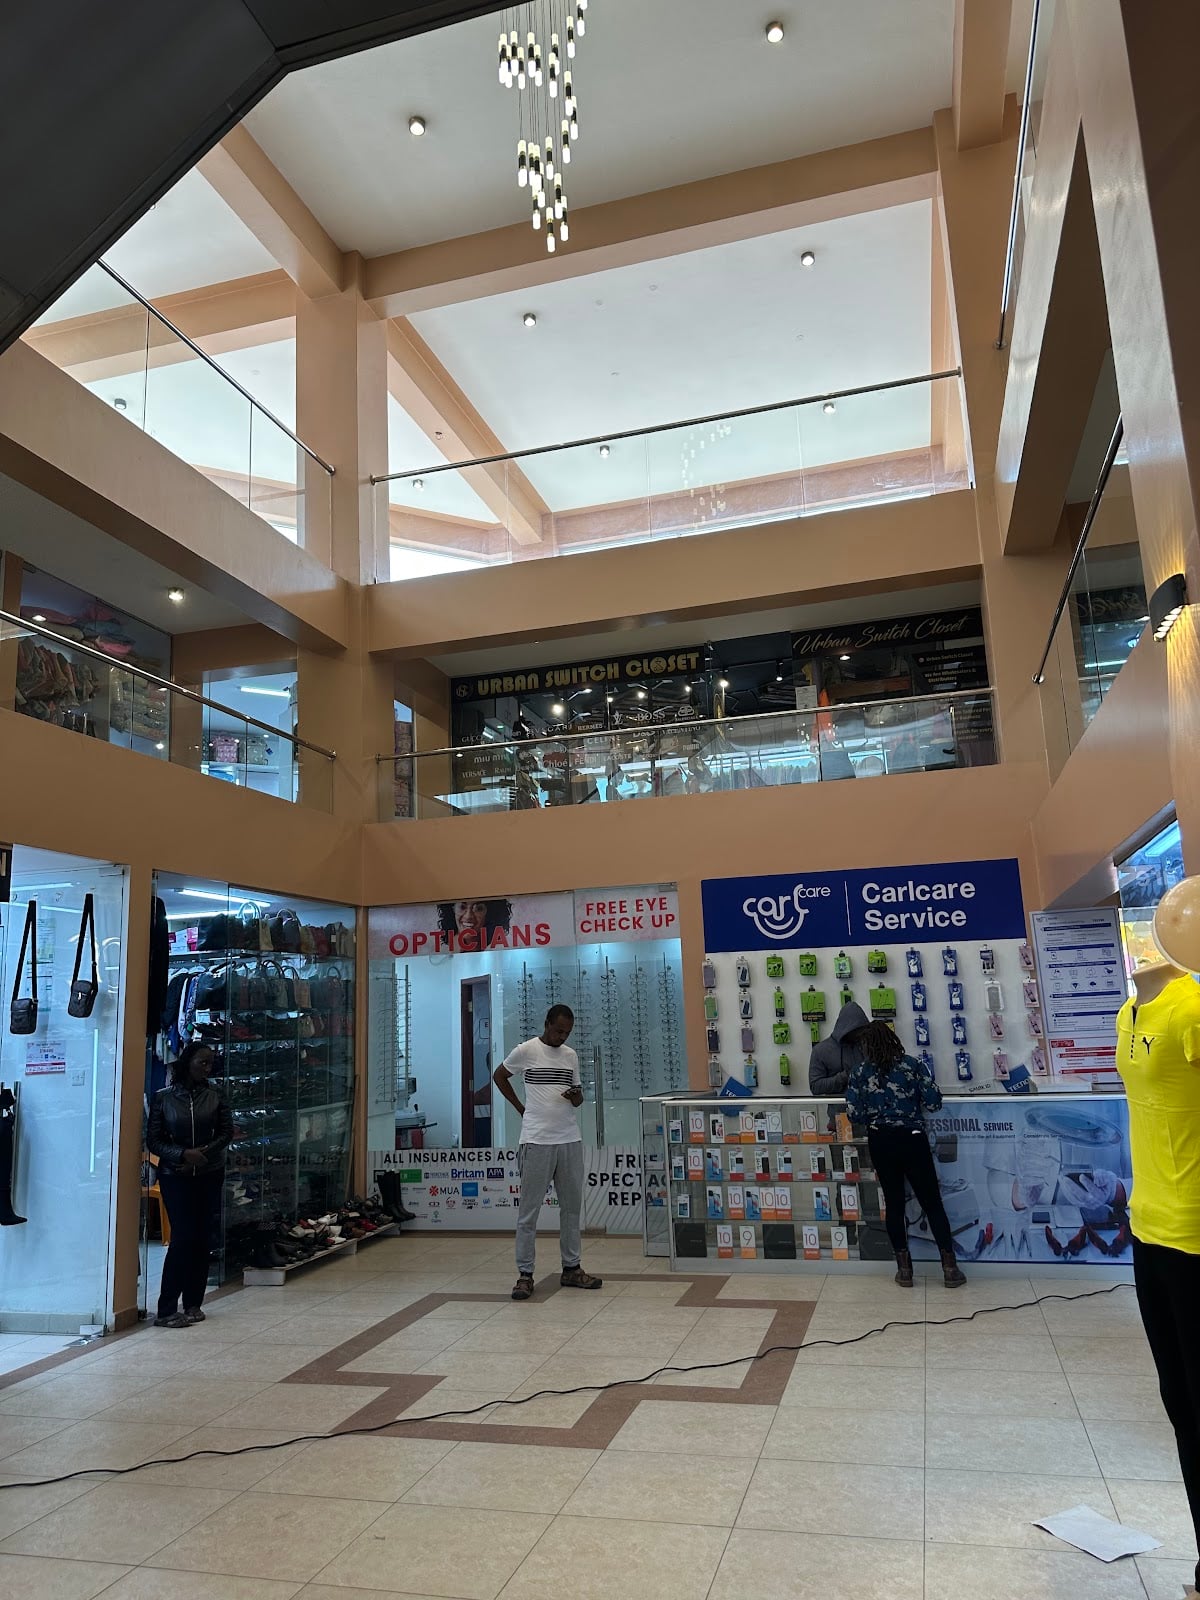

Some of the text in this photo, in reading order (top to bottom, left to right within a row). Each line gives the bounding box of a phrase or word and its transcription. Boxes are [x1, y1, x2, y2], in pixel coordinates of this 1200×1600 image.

[793, 616, 972, 654] Urban Switch Closet
[477, 652, 700, 696] URBAN SWITCH CLOSET
[798, 885, 831, 898] care
[862, 880, 976, 904] Carlcare
[585, 897, 668, 916] FREE EYE
[580, 913, 676, 934] CHECK UP
[864, 907, 967, 931] Service
[389, 923, 551, 956] OPTICIANS
[691, 1117, 703, 1130] 10
[741, 1116, 754, 1130] 10
[801, 1115, 815, 1130] 10
[983, 1122, 1014, 1132] SERVICE
[383, 1153, 404, 1164] ALL
[409, 1151, 492, 1164] INSURANCES
[689, 1155, 700, 1167] 10
[451, 1168, 485, 1179] Britam
[439, 1186, 460, 1196] MUA
[729, 1192, 741, 1205] 10
[761, 1191, 774, 1207] 10
[776, 1193, 788, 1206] 10
[843, 1194, 856, 1207] 10
[718, 1231, 731, 1244] 10
[743, 1230, 752, 1246] 9
[804, 1233, 816, 1246] 10
[834, 1231, 844, 1247] 9
